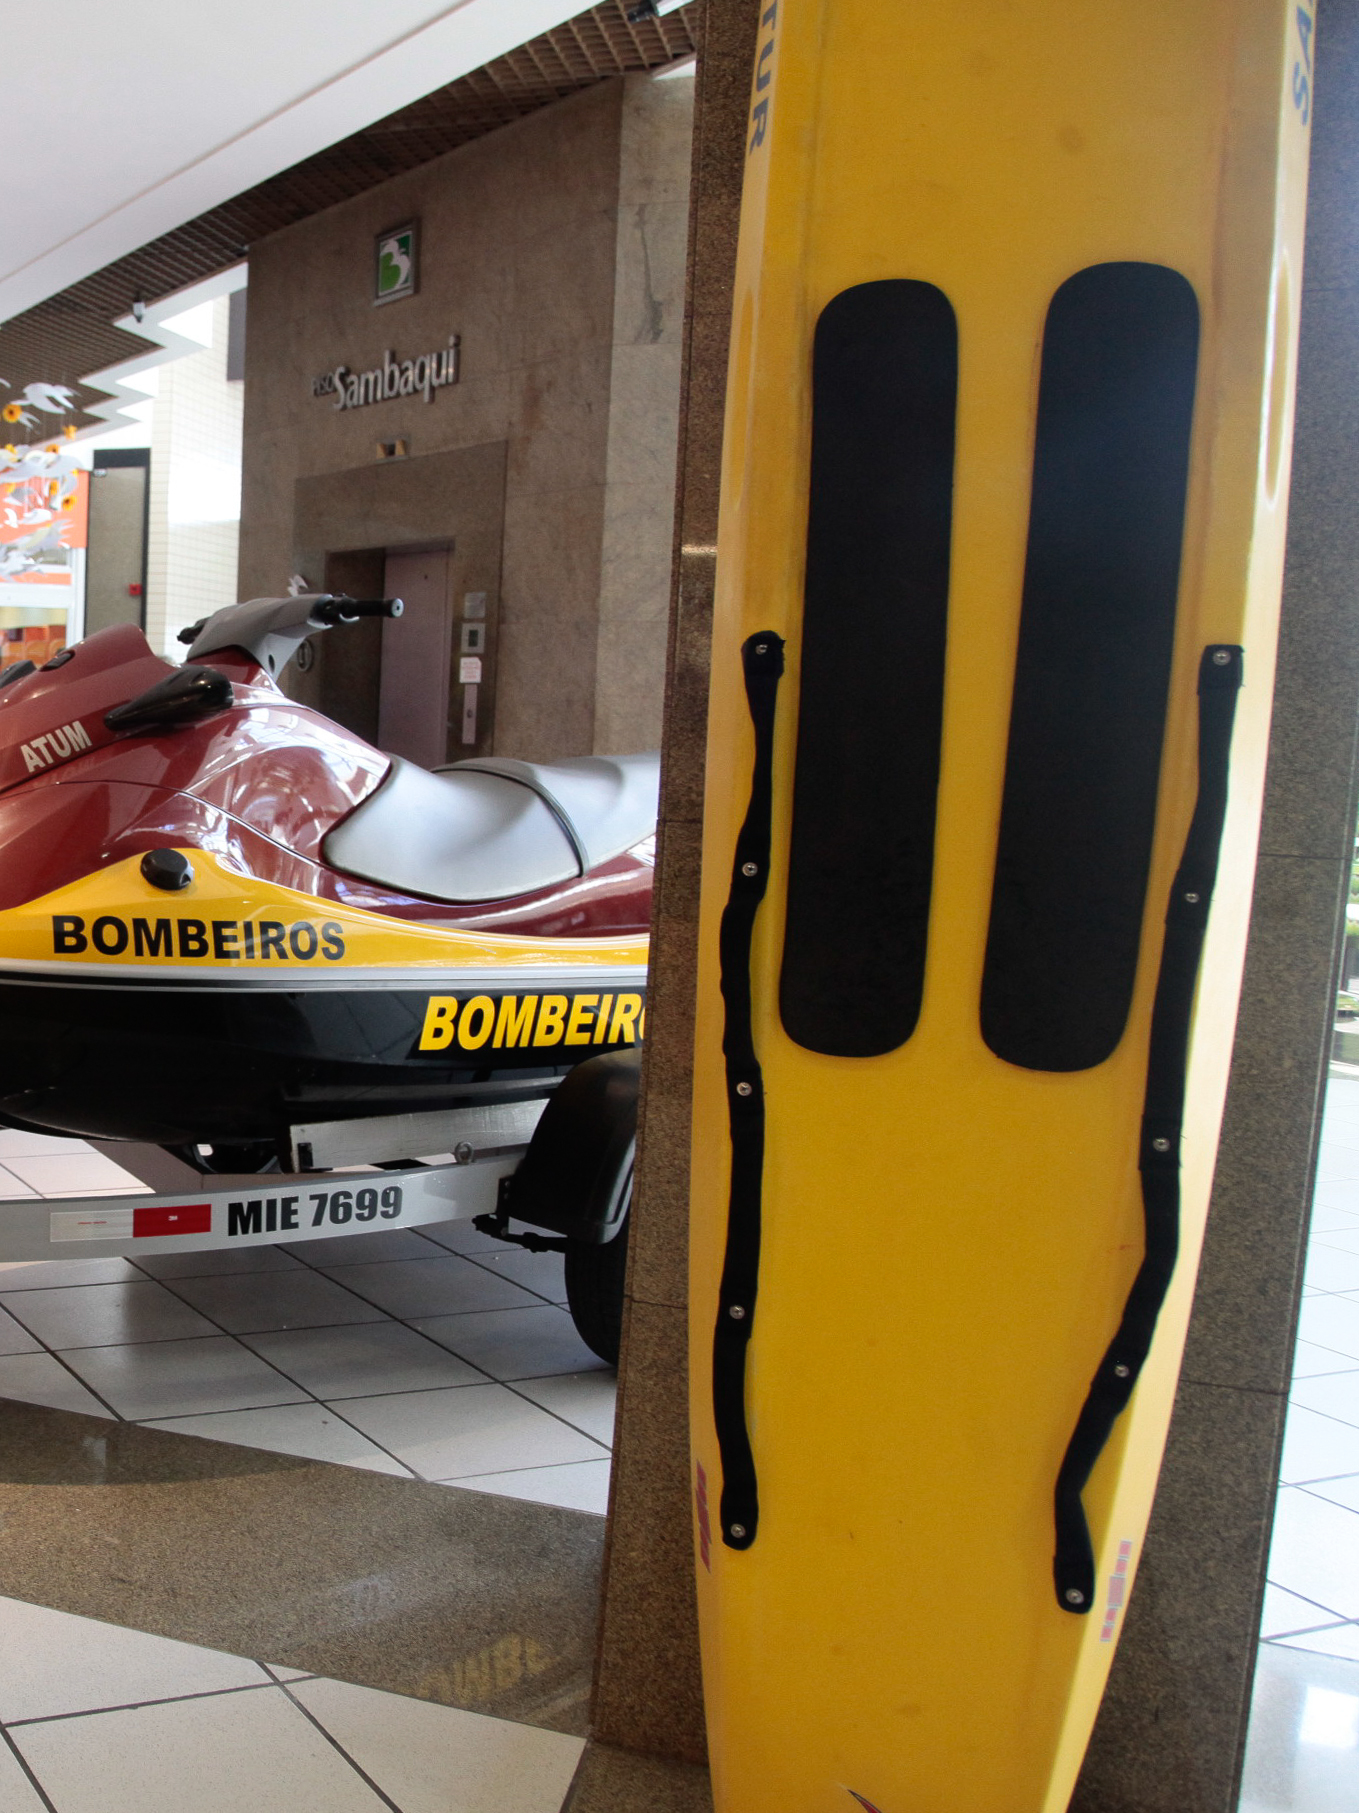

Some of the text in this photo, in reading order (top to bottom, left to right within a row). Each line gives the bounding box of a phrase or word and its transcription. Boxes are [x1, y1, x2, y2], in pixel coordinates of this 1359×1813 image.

[334, 333, 460, 411] Sambaqui
[20, 720, 93, 773] ATUM
[51, 915, 346, 961] BOMBEIROS
[418, 993, 646, 1051] BOMBEIR
[228, 1186, 403, 1237] MIE 7699
